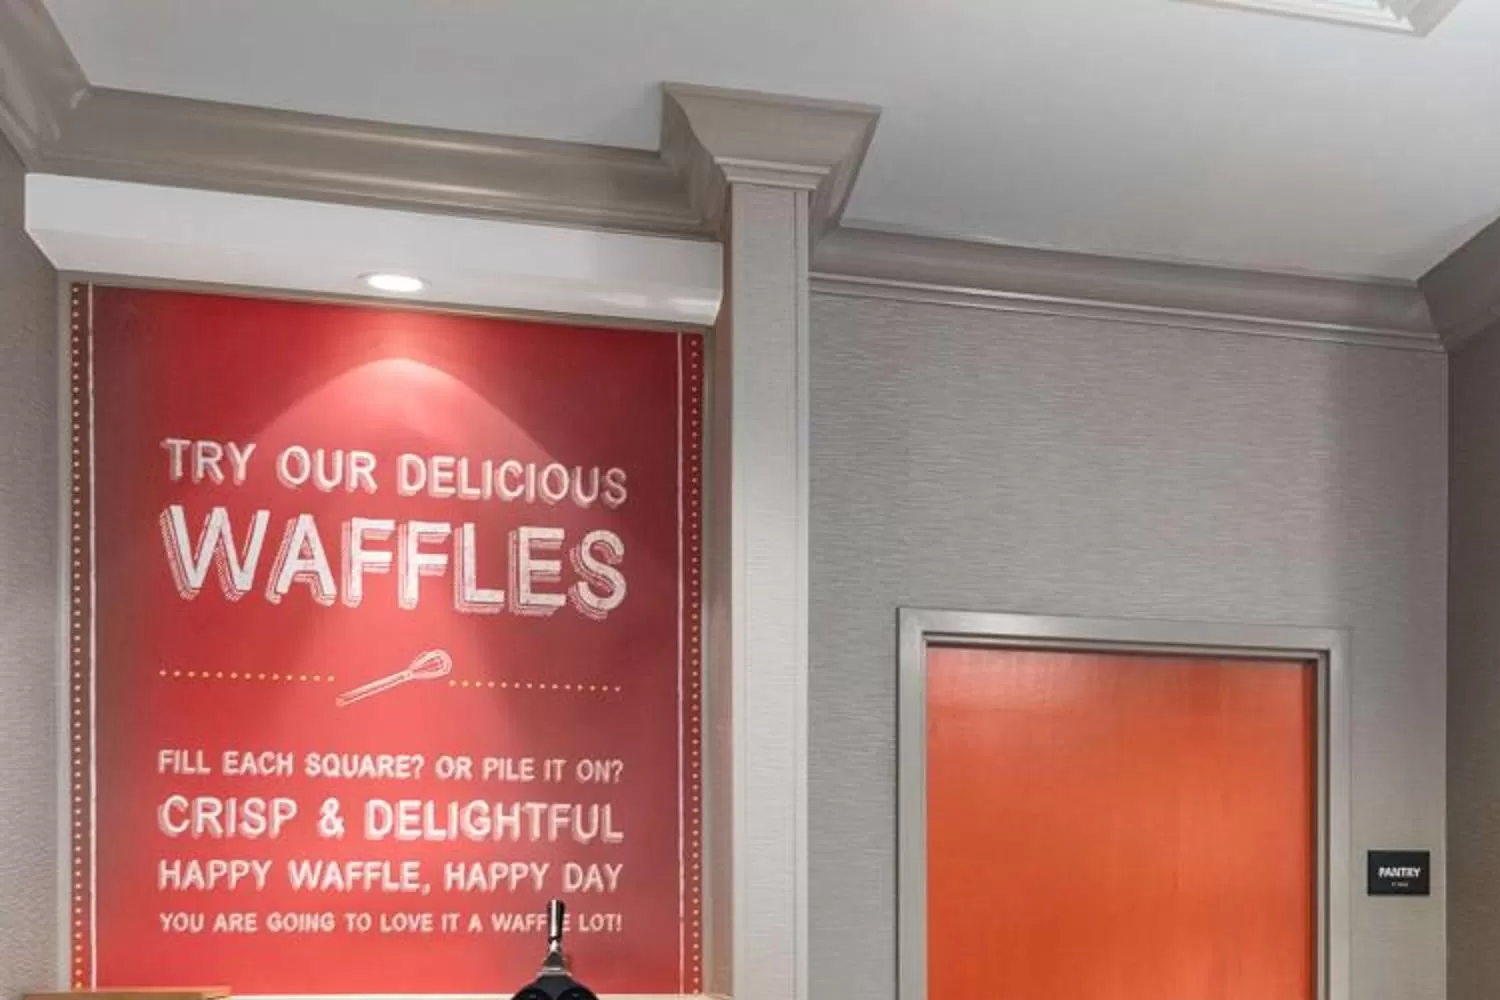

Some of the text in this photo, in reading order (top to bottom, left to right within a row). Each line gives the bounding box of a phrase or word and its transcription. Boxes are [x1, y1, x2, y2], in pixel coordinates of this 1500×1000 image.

[160, 438, 628, 509] TRY OUR DELICIOUS
[159, 504, 628, 621] WAFFLES
[157, 749, 625, 784] FILL EACH SQUARE? OR PILE IT ON?
[157, 794, 625, 844] CRISP & DELIGHTFUL
[157, 859, 624, 896] HAPPY WAFFLE, HAPPY DAY
[1379, 866, 1421, 878] PANTRY
[159, 912, 624, 934] YOU ARE GOING TO LOVE IT A WAFFE LOT!
